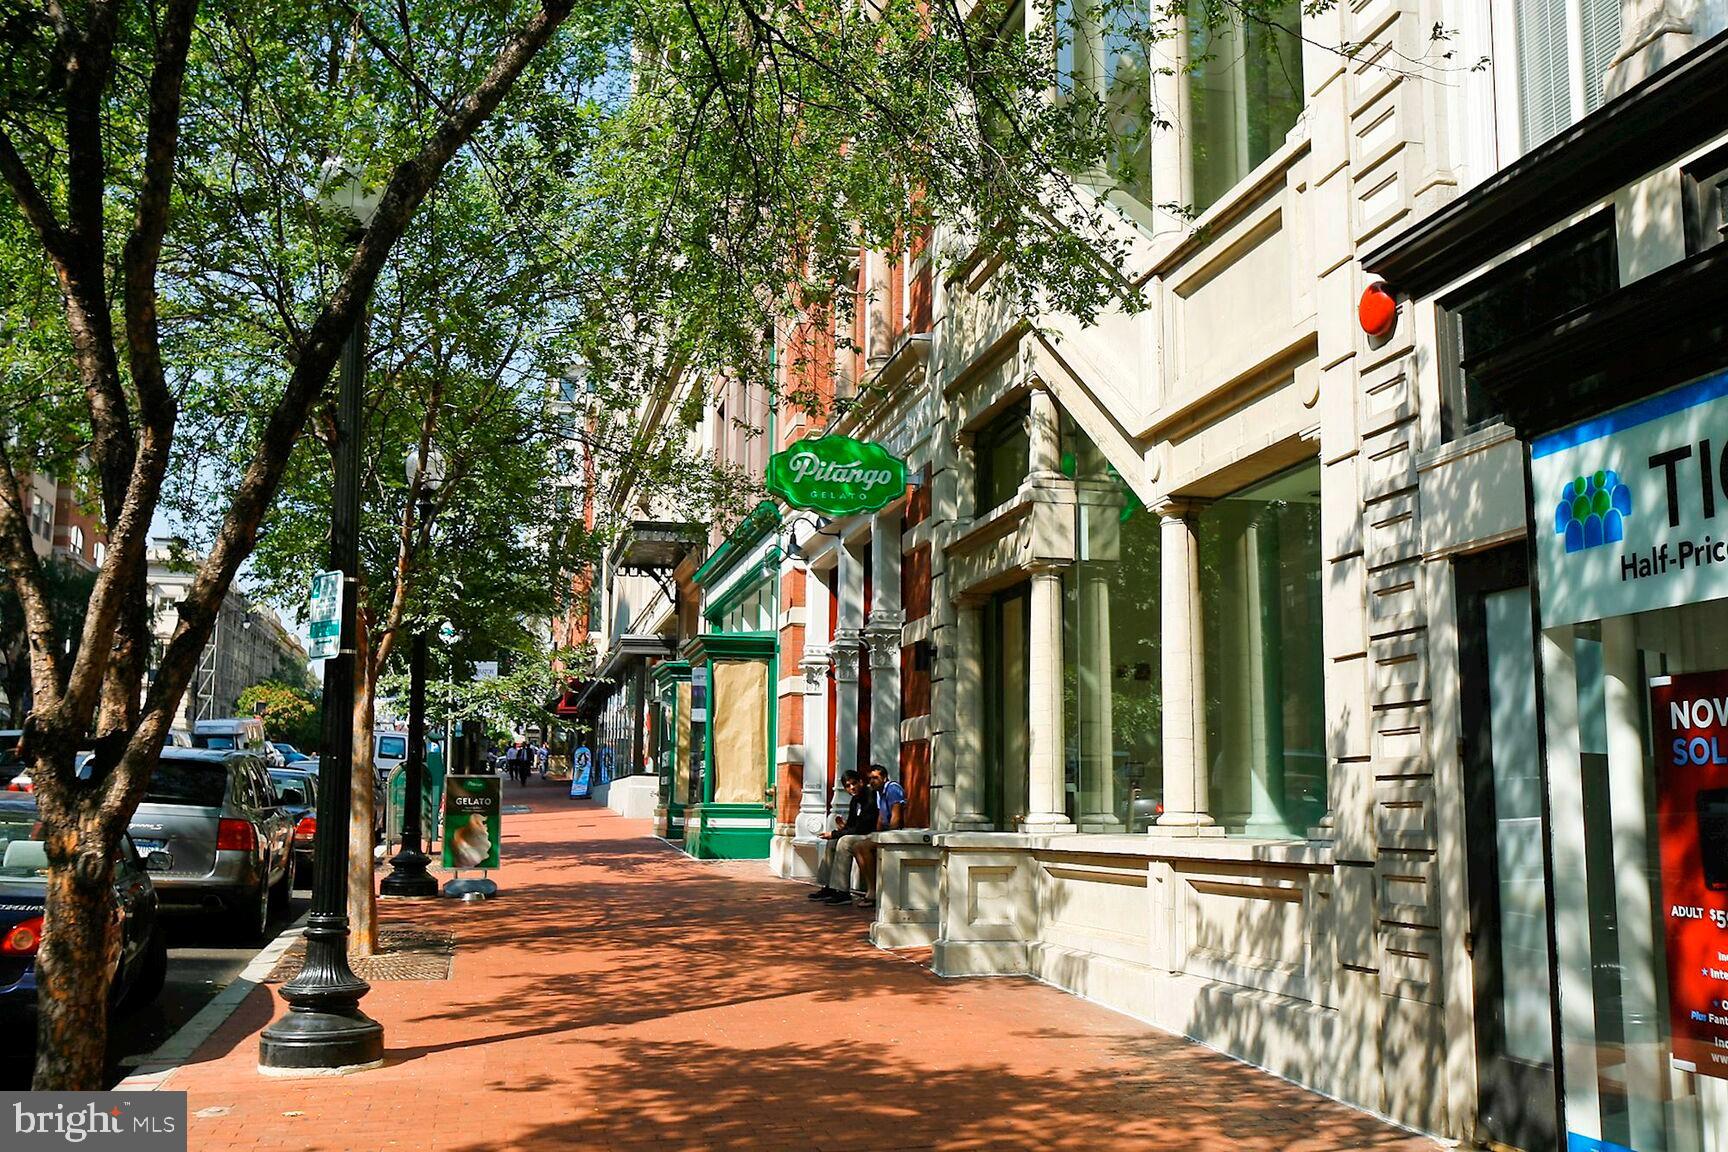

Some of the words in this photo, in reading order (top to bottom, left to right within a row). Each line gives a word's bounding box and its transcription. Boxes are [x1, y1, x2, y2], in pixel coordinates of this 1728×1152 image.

[789, 451, 892, 491] Pitango
[1648, 438, 1728, 528] TI
[810, 490, 867, 500] GELATO
[1620, 535, 1728, 581] Half-Pric
[455, 797, 492, 806] GELATO
[1671, 905, 1704, 919] ADULT
[1709, 908, 1728, 929] $5
[1690, 1010, 1707, 1022] Plus
